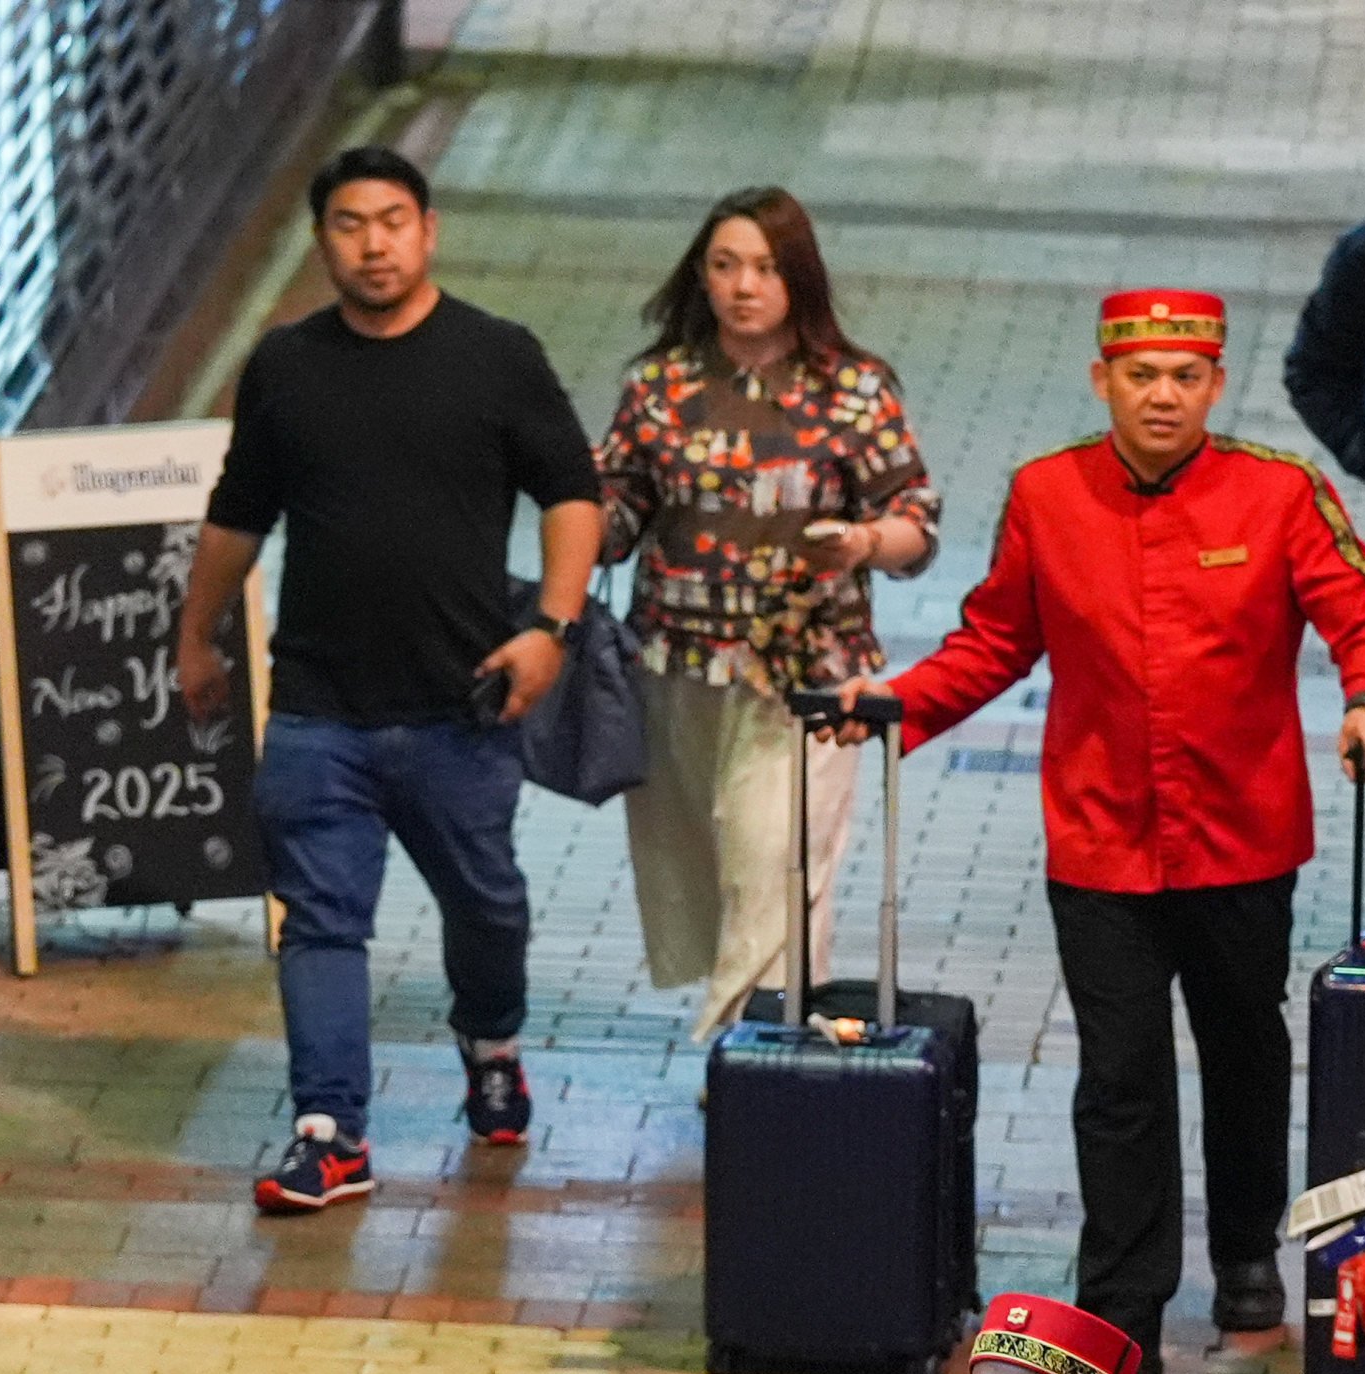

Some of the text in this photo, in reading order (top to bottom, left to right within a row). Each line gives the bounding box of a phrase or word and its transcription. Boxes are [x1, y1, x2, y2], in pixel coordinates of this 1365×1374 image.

[31, 560, 187, 645] Happy
[31, 663, 123, 720] New
[81, 762, 225, 823] 2025
